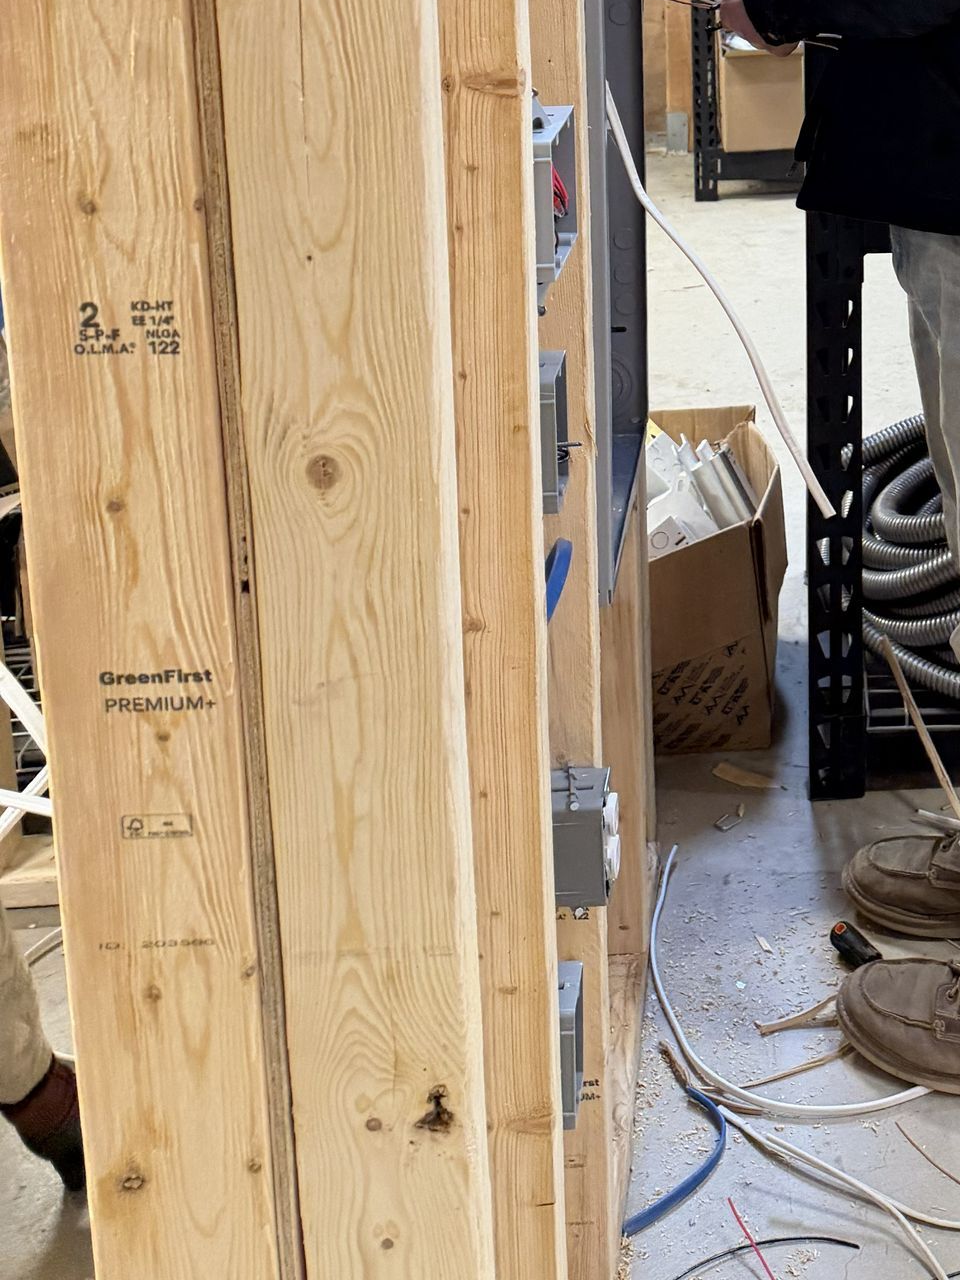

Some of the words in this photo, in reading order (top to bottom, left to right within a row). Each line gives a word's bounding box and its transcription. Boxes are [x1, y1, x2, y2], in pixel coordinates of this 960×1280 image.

[130, 300, 174, 312] KD-HT
[80, 302, 101, 328] 2
[79, 328, 121, 342] S-P-F
[145, 328, 181, 340] NLGA
[148, 340, 181, 355] 122
[99, 669, 213, 686] GreenFirst
[104, 695, 217, 713] PREMIUM+
